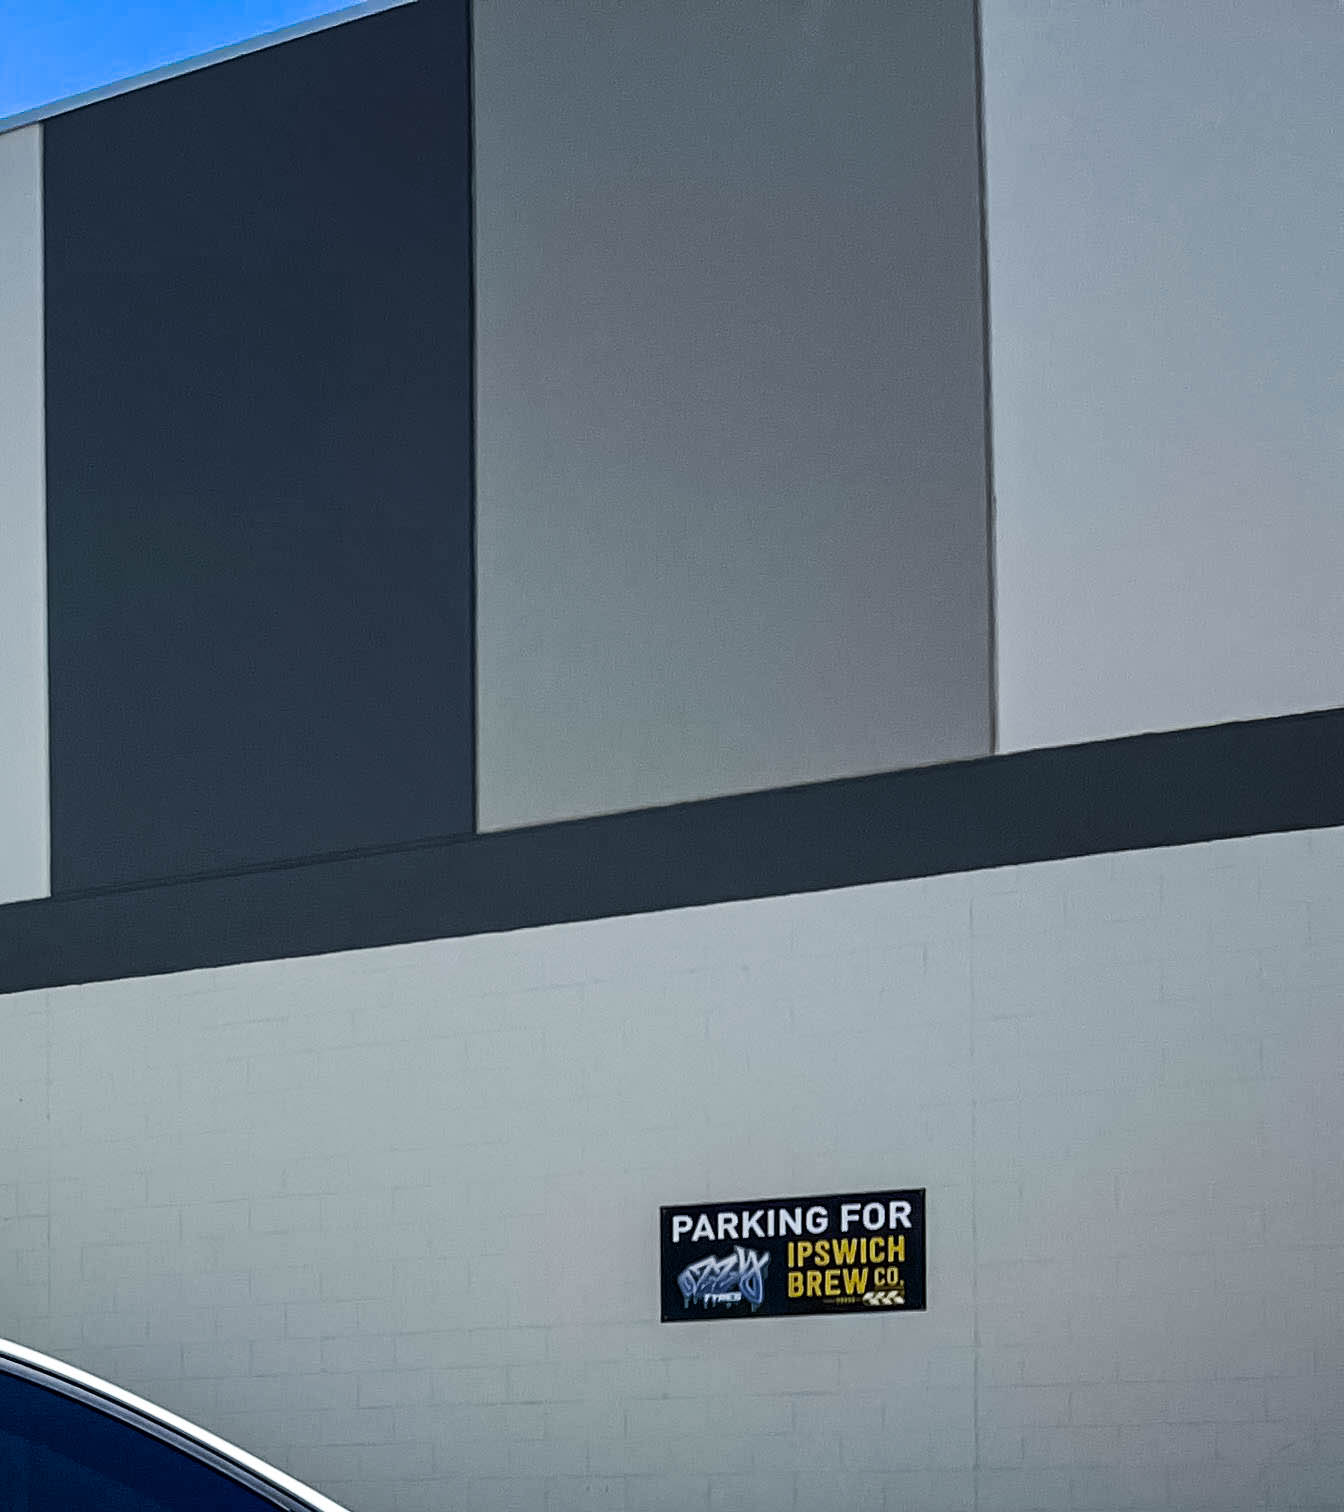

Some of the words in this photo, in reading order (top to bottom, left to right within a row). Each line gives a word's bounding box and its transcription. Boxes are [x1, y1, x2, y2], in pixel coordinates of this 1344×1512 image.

[671, 1205, 829, 1243] PARKING
[840, 1200, 912, 1233] FOR
[787, 1234, 906, 1268] IPSWICH
[787, 1267, 869, 1298] BREW
